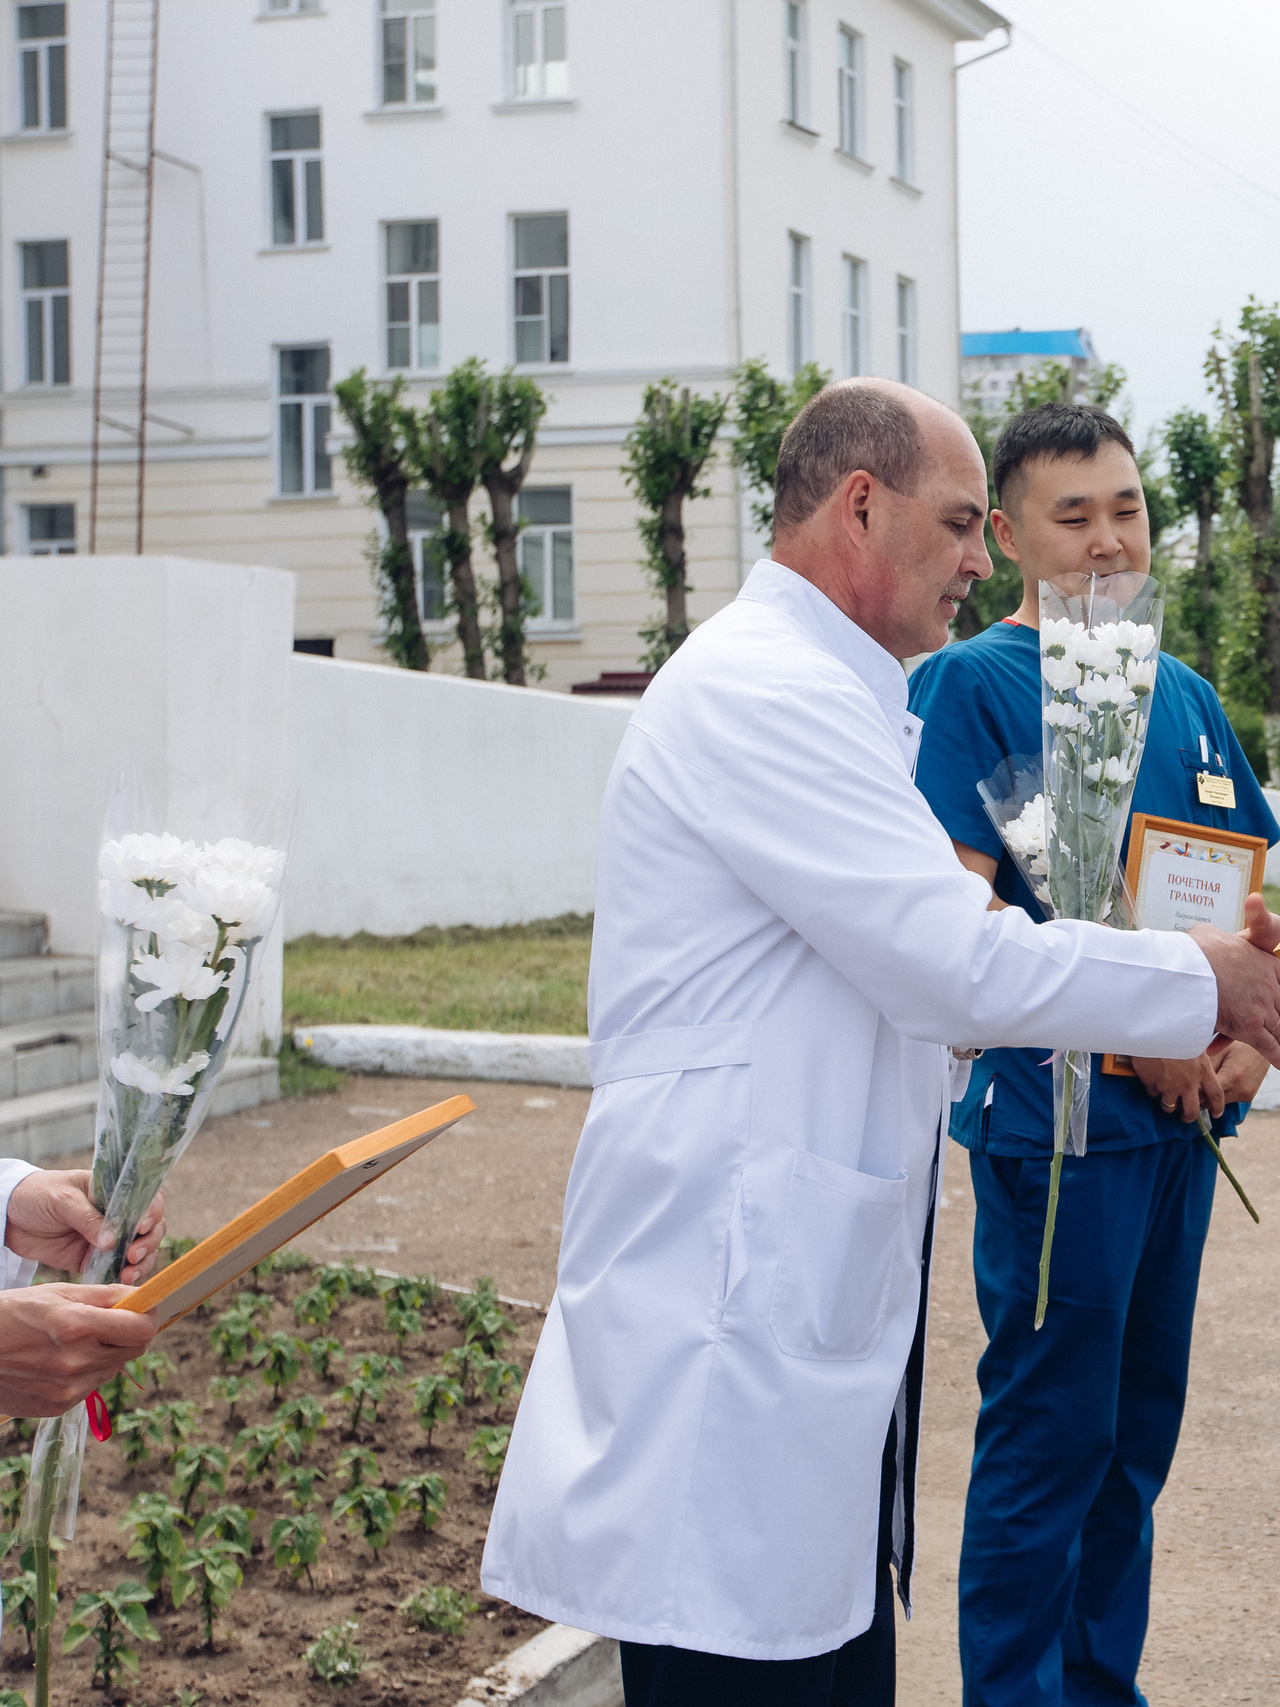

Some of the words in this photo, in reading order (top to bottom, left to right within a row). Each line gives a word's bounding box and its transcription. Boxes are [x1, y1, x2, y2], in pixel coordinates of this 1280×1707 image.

[1167, 873, 1221, 893] ПОЧЕТНАЯ
[1169, 890, 1215, 907] ГРАМОТА
[1175, 911, 1211, 923] Награждается
